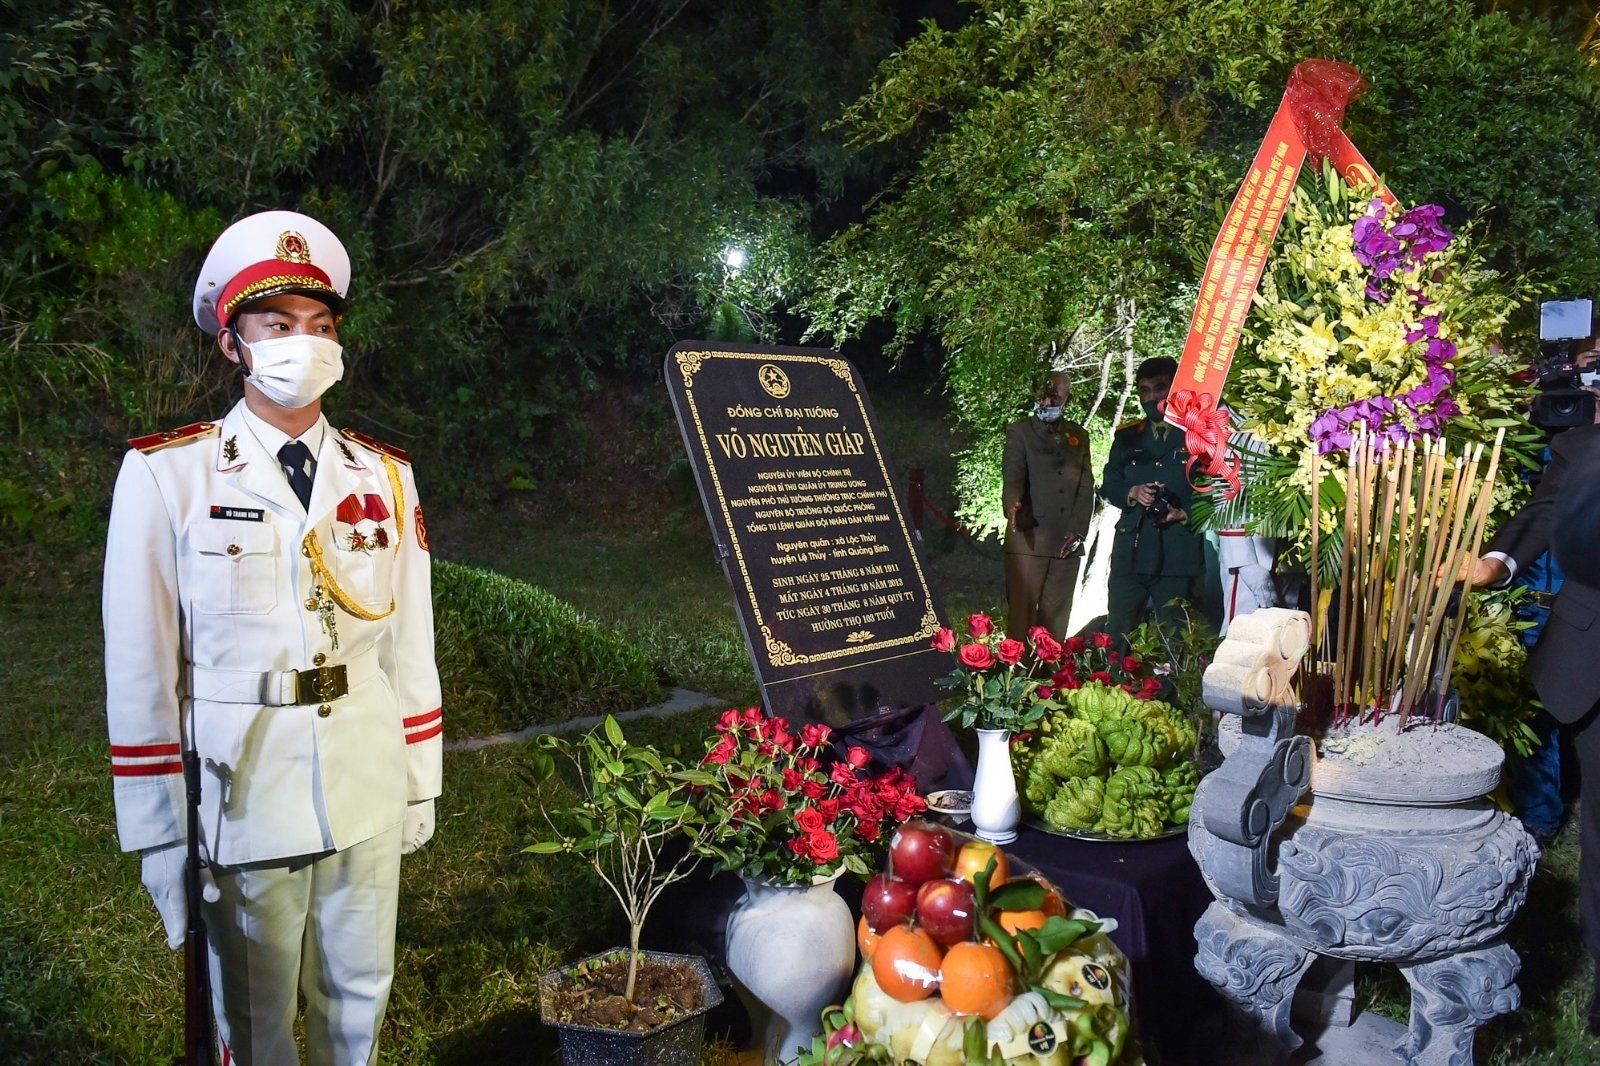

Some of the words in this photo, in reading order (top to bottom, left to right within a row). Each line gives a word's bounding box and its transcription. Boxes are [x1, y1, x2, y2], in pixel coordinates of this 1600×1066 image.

[728, 403, 762, 418] ĐỒNG
[765, 405, 783, 418] CHÍ
[785, 408, 801, 420] ĐẠI
[804, 406, 838, 418] TƯỚNG
[716, 427, 747, 459] VÕ
[747, 426, 825, 458] NGUYÊN
[826, 426, 864, 455] GIÁP
[747, 522, 767, 533] TỔNG
[770, 553, 797, 565] huyện
[799, 552, 808, 563] Lệ
[809, 550, 826, 561] Thủy
[848, 545, 874, 557] Quảng
[776, 540, 808, 553] Nguyên
[810, 538, 830, 551] quán
[846, 535, 860, 545] Lộc
[861, 533, 876, 543] Thủy
[772, 577, 795, 588] SINH
[797, 572, 819, 585] NGÀY
[831, 567, 859, 580] THÁNG
[860, 568, 865, 576] 8
[865, 564, 883, 575] NĂM
[884, 564, 899, 572] 1911
[779, 590, 799, 604] MẤT
[800, 587, 824, 600] NGÀY
[831, 582, 859, 595] THÁNG
[869, 579, 887, 591] NĂM
[888, 578, 903, 587] 2013
[776, 608, 795, 621] TỨC
[797, 604, 820, 618] NGÀY
[822, 606, 831, 614] 30
[832, 598, 860, 613] THÁNG
[869, 596, 886, 608] NĂM
[888, 591, 903, 604] QUÝ
[811, 617, 844, 632] HƯỞNG
[844, 617, 861, 627] THỌ
[862, 614, 875, 622] 103
[875, 607, 895, 620] TUỔI
